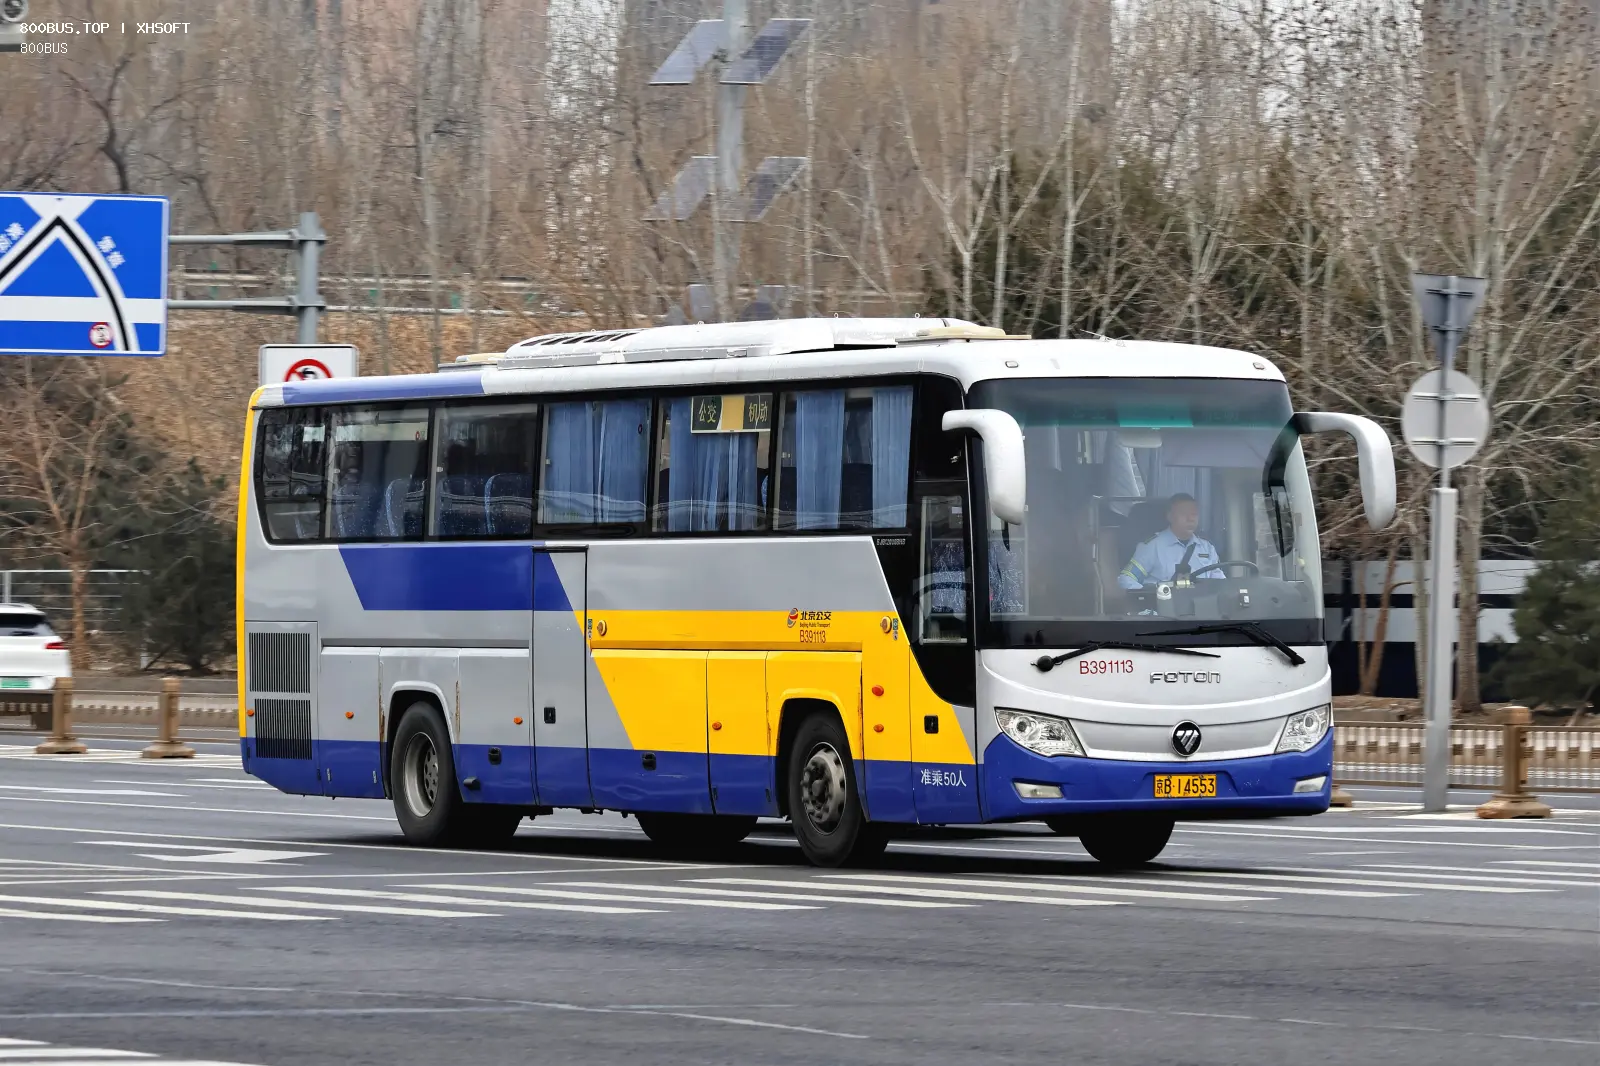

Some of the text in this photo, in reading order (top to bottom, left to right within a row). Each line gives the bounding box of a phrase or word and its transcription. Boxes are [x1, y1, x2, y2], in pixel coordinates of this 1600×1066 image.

[699, 399, 717, 423] 公交
[800, 611, 832, 621] 北京公交
[799, 629, 826, 643] B391113
[1079, 659, 1134, 675] B391113
[920, 768, 967, 787] 准乘50人
